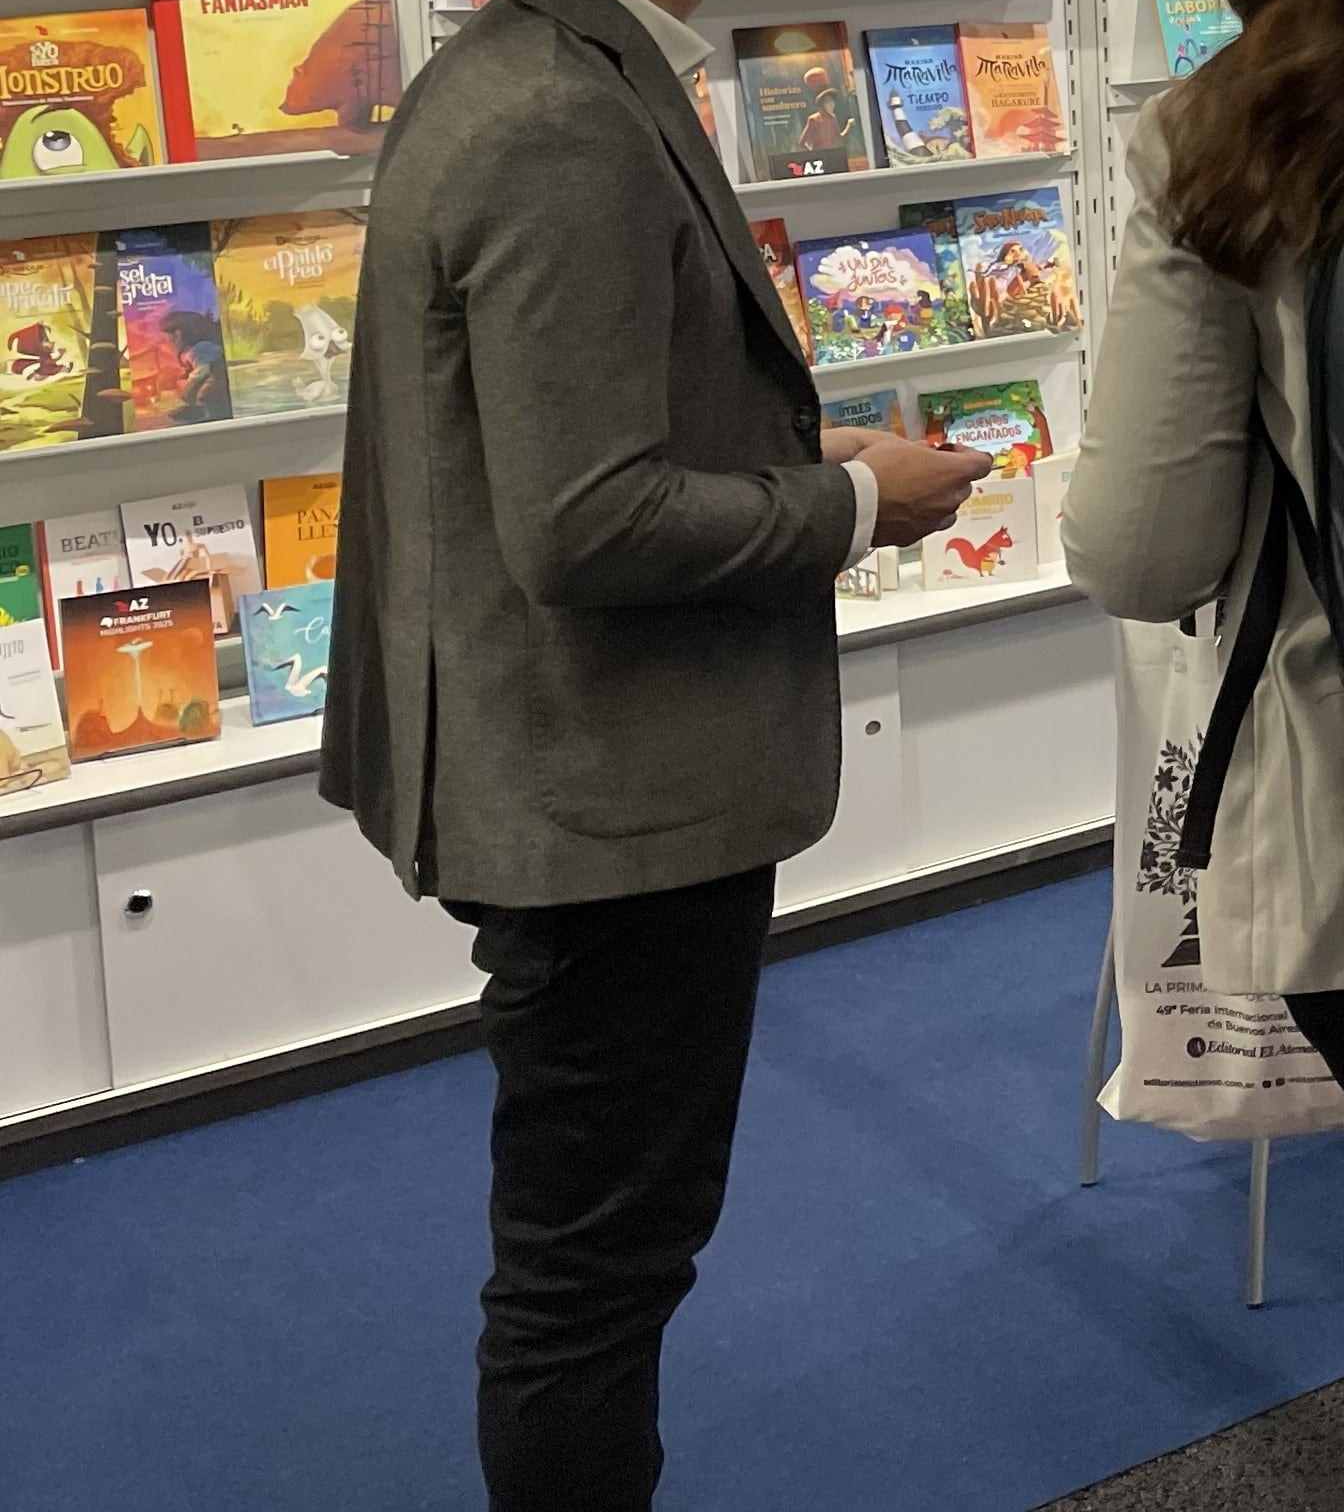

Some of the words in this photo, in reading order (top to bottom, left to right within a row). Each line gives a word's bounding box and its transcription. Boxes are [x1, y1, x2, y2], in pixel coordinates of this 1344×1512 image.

[804, 160, 824, 176] AZ
[965, 414, 1009, 428] CUENTOS
[956, 424, 1022, 443] ENCANTADOS
[129, 598, 149, 611] AZ
[114, 610, 172, 625] FRANKFURT
[1145, 982, 1162, 993] LA
[1167, 982, 1208, 993] PRIM
[1180, 1005, 1210, 1014] Feria
[1207, 1020, 1222, 1029] de
[1226, 1021, 1265, 1035] Buenos
[1207, 1041, 1256, 1057] Editorial
